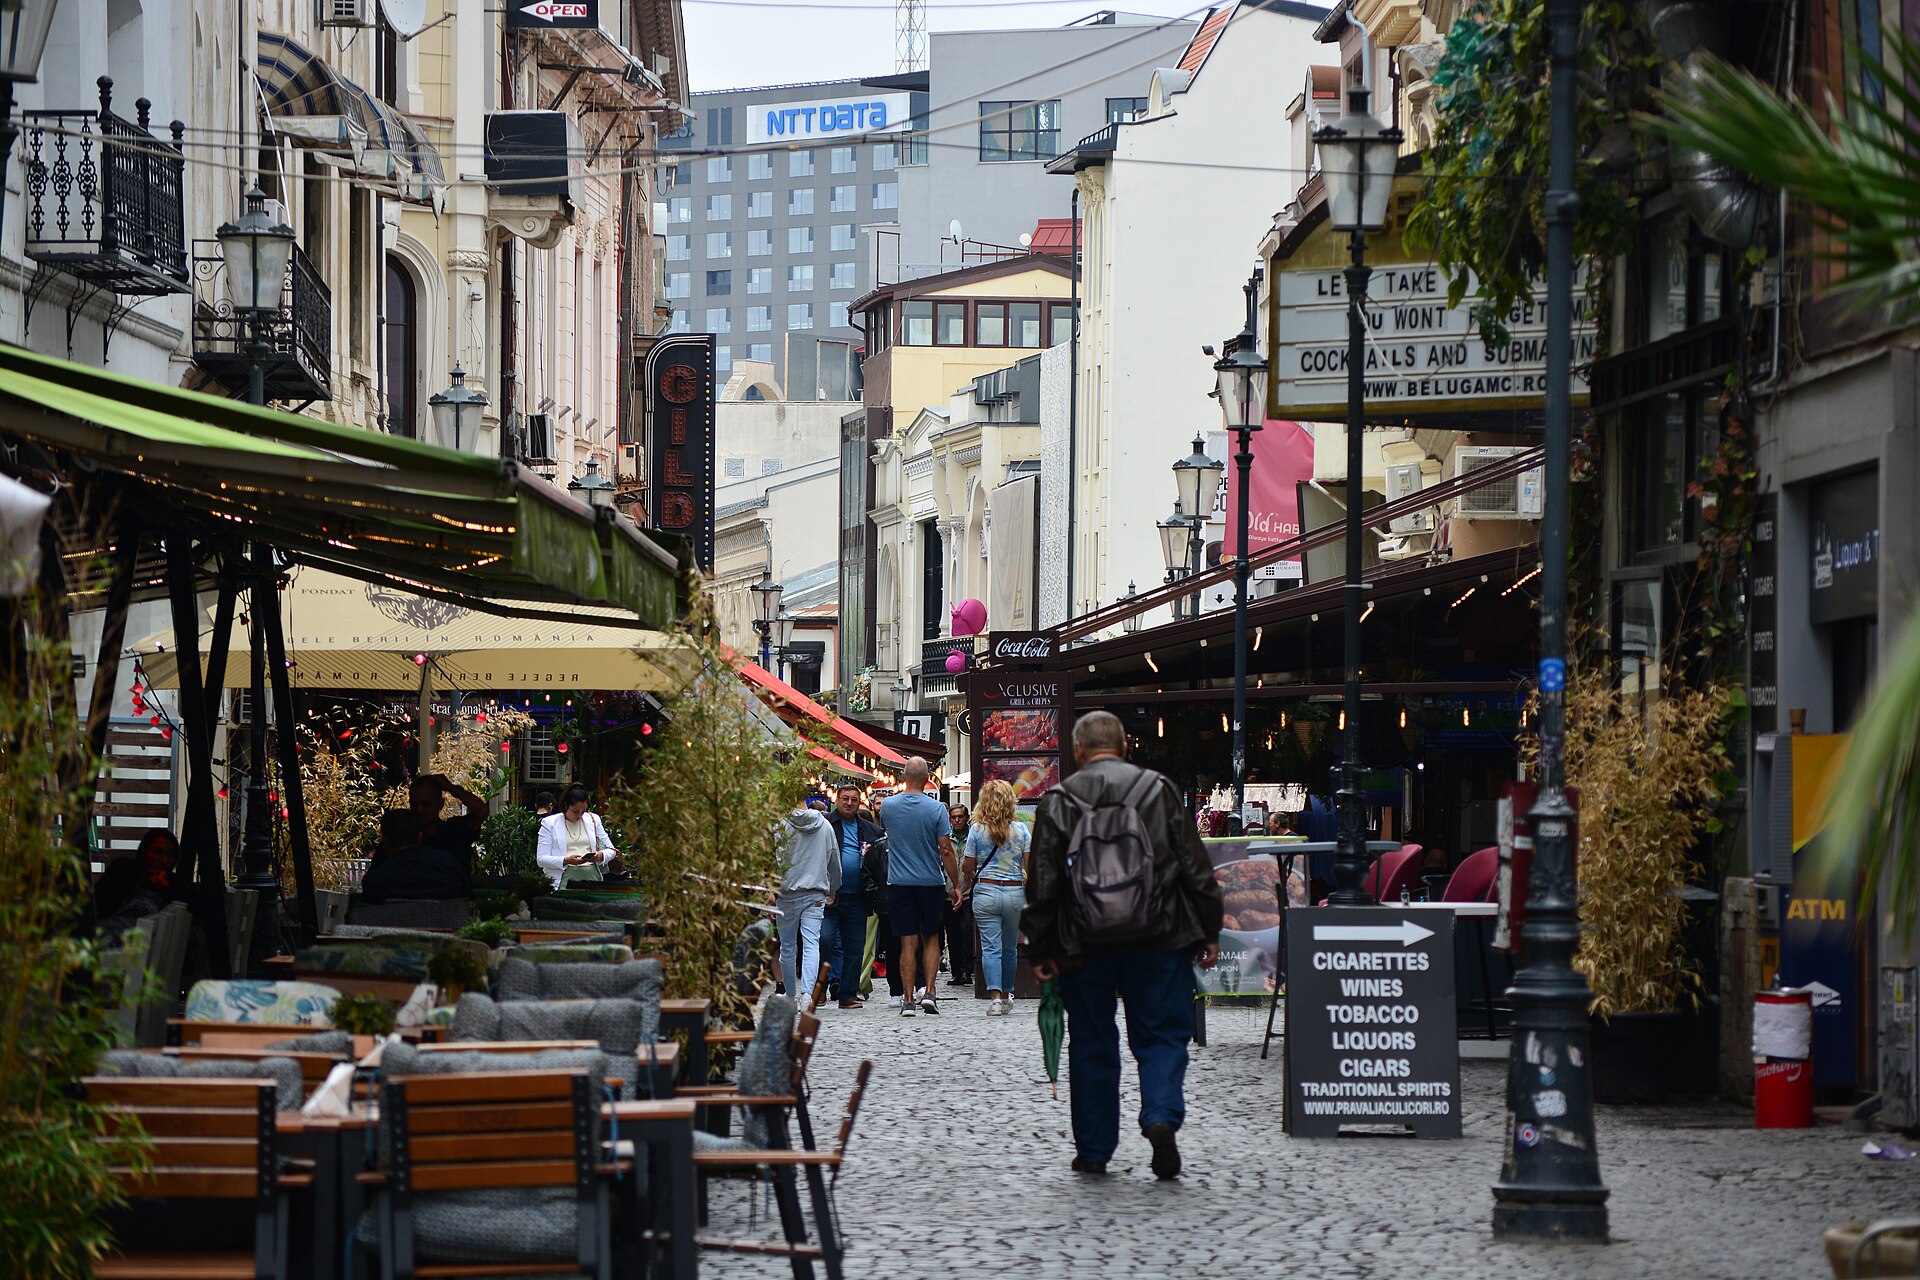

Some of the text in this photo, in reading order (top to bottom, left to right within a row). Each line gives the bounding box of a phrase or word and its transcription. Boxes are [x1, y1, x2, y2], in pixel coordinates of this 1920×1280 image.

[535, 5, 586, 16] OPEN
[767, 107, 816, 135] NTT
[1386, 270, 1437, 293] TAKE
[1394, 305, 1446, 329] WONT
[1301, 344, 1416, 373] COCKAILS
[1427, 343, 1468, 367] AND
[1756, 521, 1774, 541] WINES
[1754, 576, 1774, 596] CIGARS
[353, 635, 409, 644] BERII
[1754, 631, 1774, 651] SPIRITS
[1009, 698, 1025, 706] GRILL
[1751, 686, 1777, 706] TOBACCO
[1786, 899, 1846, 920] ATM
[1221, 964, 1239, 973] RON
[1312, 951, 1430, 971] CIGARETTES
[1340, 978, 1404, 998] WINES
[1326, 1004, 1419, 1024] TOBACCO
[1332, 1031, 1416, 1051] LIQUORS
[1339, 1058, 1411, 1078] CIGARS
[1301, 1081, 1451, 1097] TRADITIONAL SPIRITS
[1304, 1100, 1450, 1116] WWW.PRAVALIACULICORI.RO
